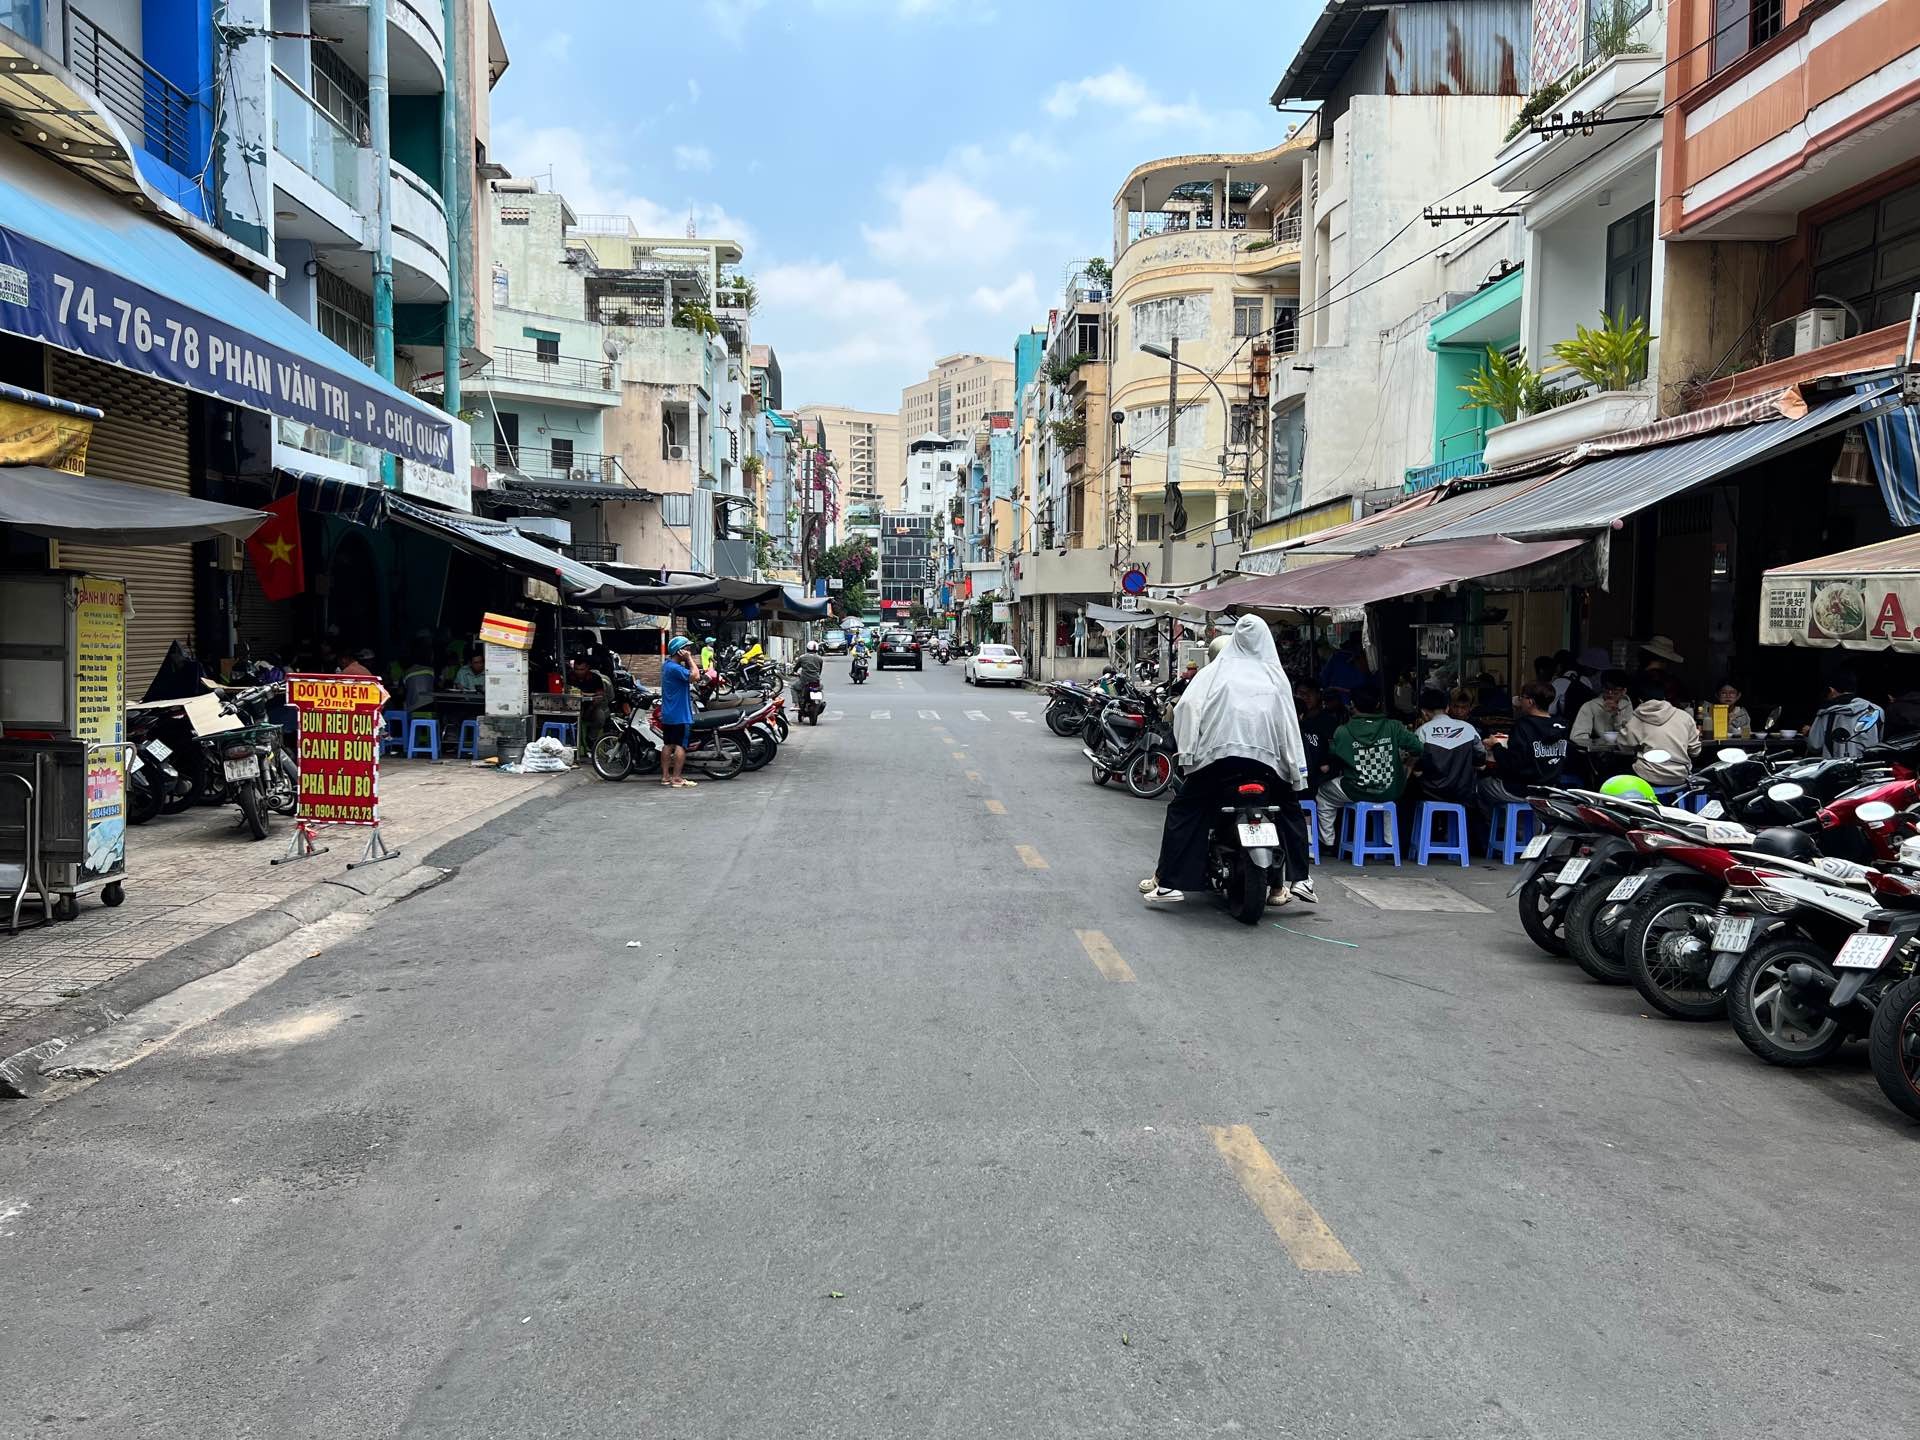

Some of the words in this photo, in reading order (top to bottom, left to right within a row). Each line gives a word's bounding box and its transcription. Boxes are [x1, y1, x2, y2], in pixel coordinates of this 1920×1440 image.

[54, 274, 200, 369] 74-76-78
[209, 335, 272, 395] PHAN
[277, 362, 317, 411] VĂN
[321, 381, 350, 431] TRỊ
[366, 400, 381, 435] P.
[385, 408, 414, 453] CHỢ
[317, 698, 331, 707] 20
[302, 708, 322, 733] BÚN
[352, 714, 372, 736] CUA
[302, 738, 339, 760] CANH
[344, 736, 372, 762] BÚN
[301, 768, 325, 795] PHÁ
[329, 767, 352, 797] LẤU
[355, 770, 371, 798] BÒ
[315, 804, 372, 820] 0904.74.73.73
